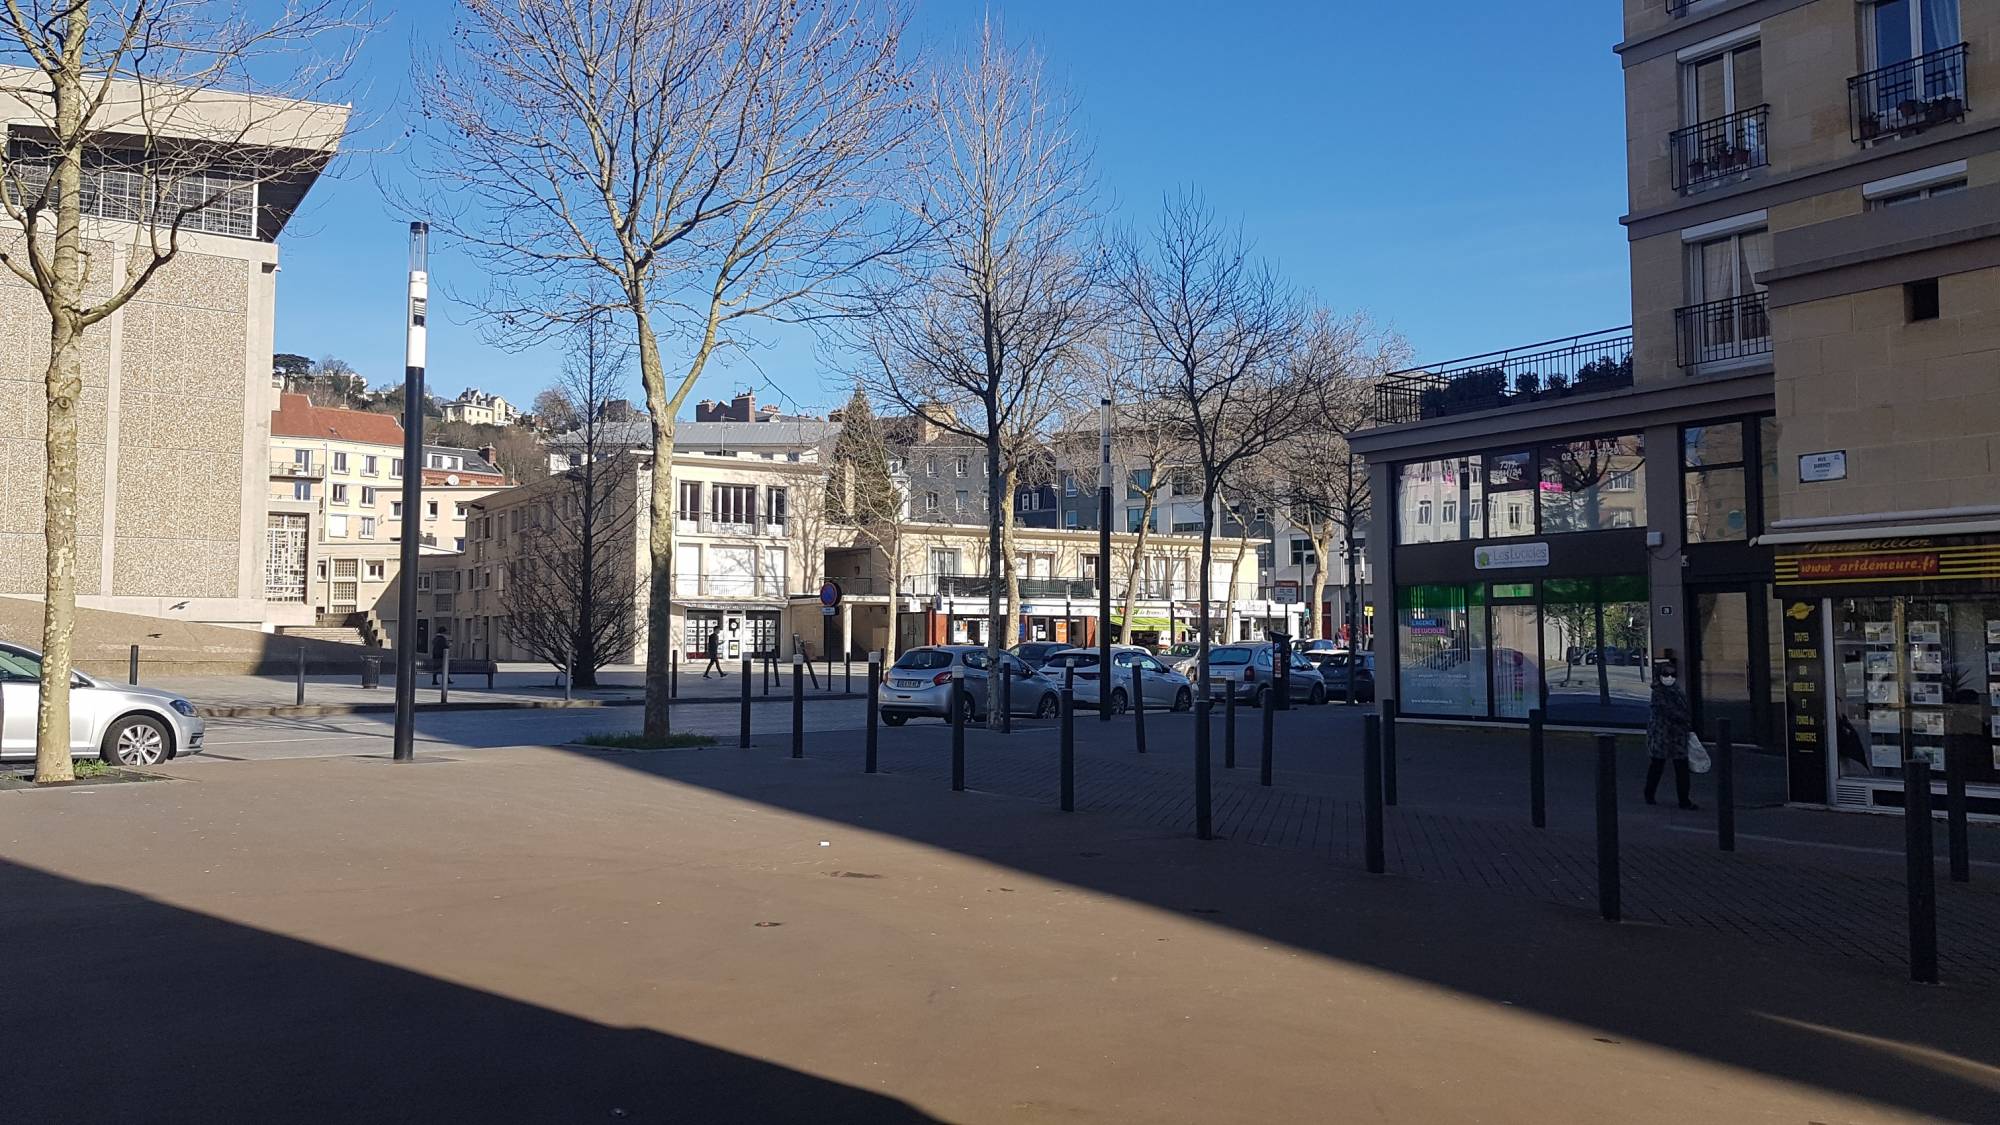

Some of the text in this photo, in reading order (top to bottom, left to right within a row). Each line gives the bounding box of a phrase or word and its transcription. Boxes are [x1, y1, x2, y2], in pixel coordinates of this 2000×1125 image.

[1561, 453, 1573, 461] 02
[1574, 451, 1584, 460] 32
[1839, 556, 1936, 573] artdemeure.fr
[1274, 643, 1280, 651] P
[1788, 648, 1817, 658] TRANSACTIONS
[1795, 732, 1816, 742] COMMERCE
